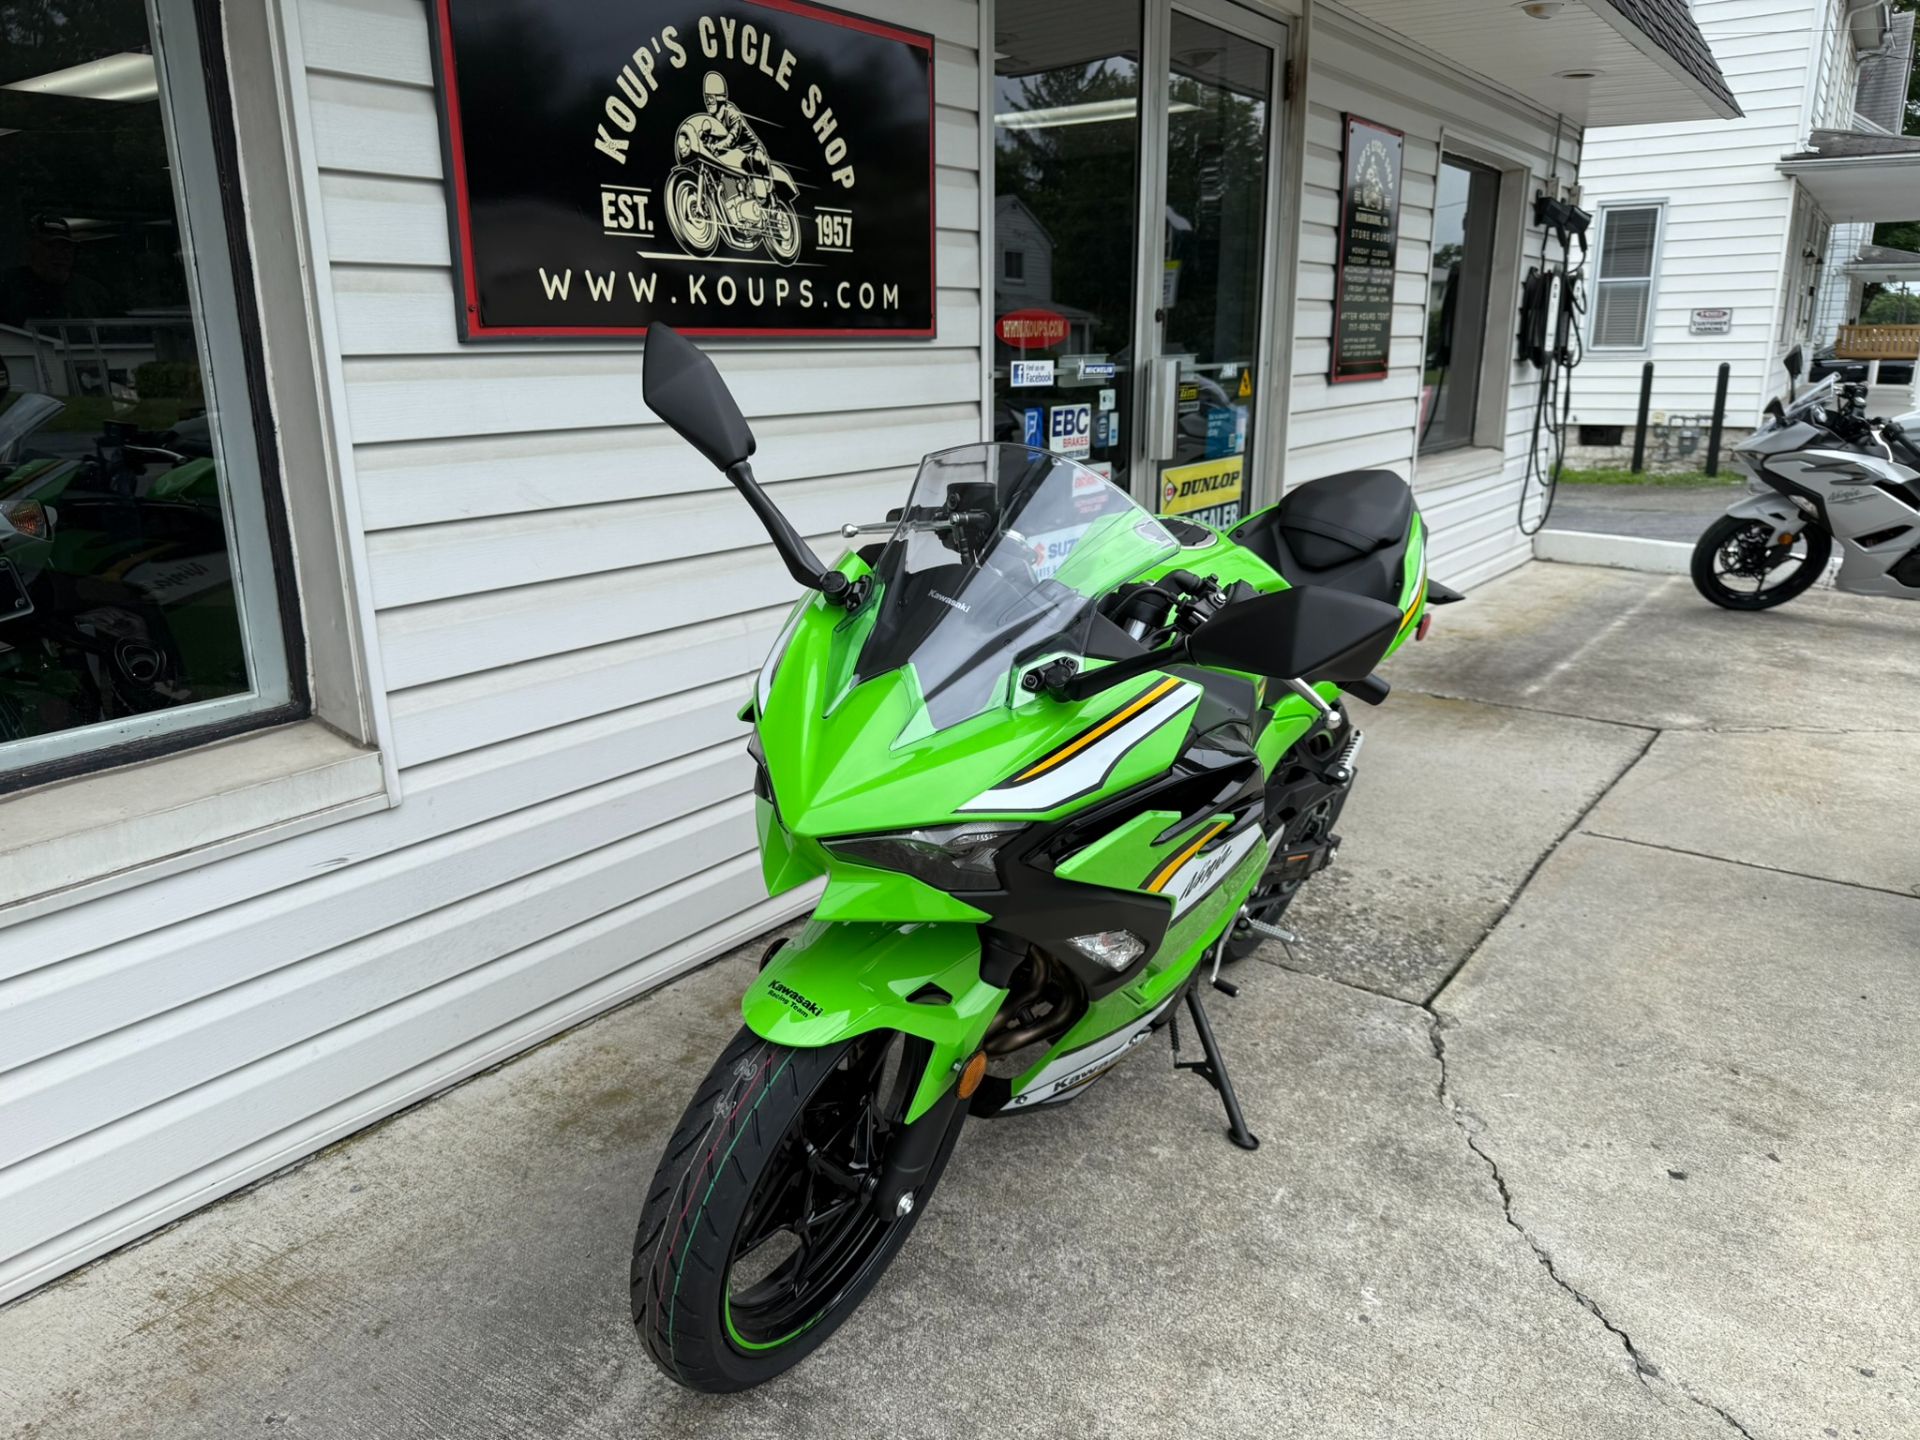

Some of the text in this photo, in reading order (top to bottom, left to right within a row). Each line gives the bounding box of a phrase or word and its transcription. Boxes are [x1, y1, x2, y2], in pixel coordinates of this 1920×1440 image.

[594, 16, 856, 190] KOUP'S CYCLE SHOP
[601, 192, 654, 231] EST.
[815, 215, 853, 248] 1957
[539, 267, 899, 310] WWW.KOUPS.COM
[1026, 373, 1052, 383] Facebook
[1052, 408, 1089, 437] EBC
[1063, 436, 1088, 448] BRAKES
[1178, 471, 1240, 498] DUNLOP
[1192, 503, 1238, 531] EALER
[928, 589, 971, 613] Kawasaki
[767, 989, 809, 1018] Racing Team
[768, 980, 824, 1017] Kawasaki
